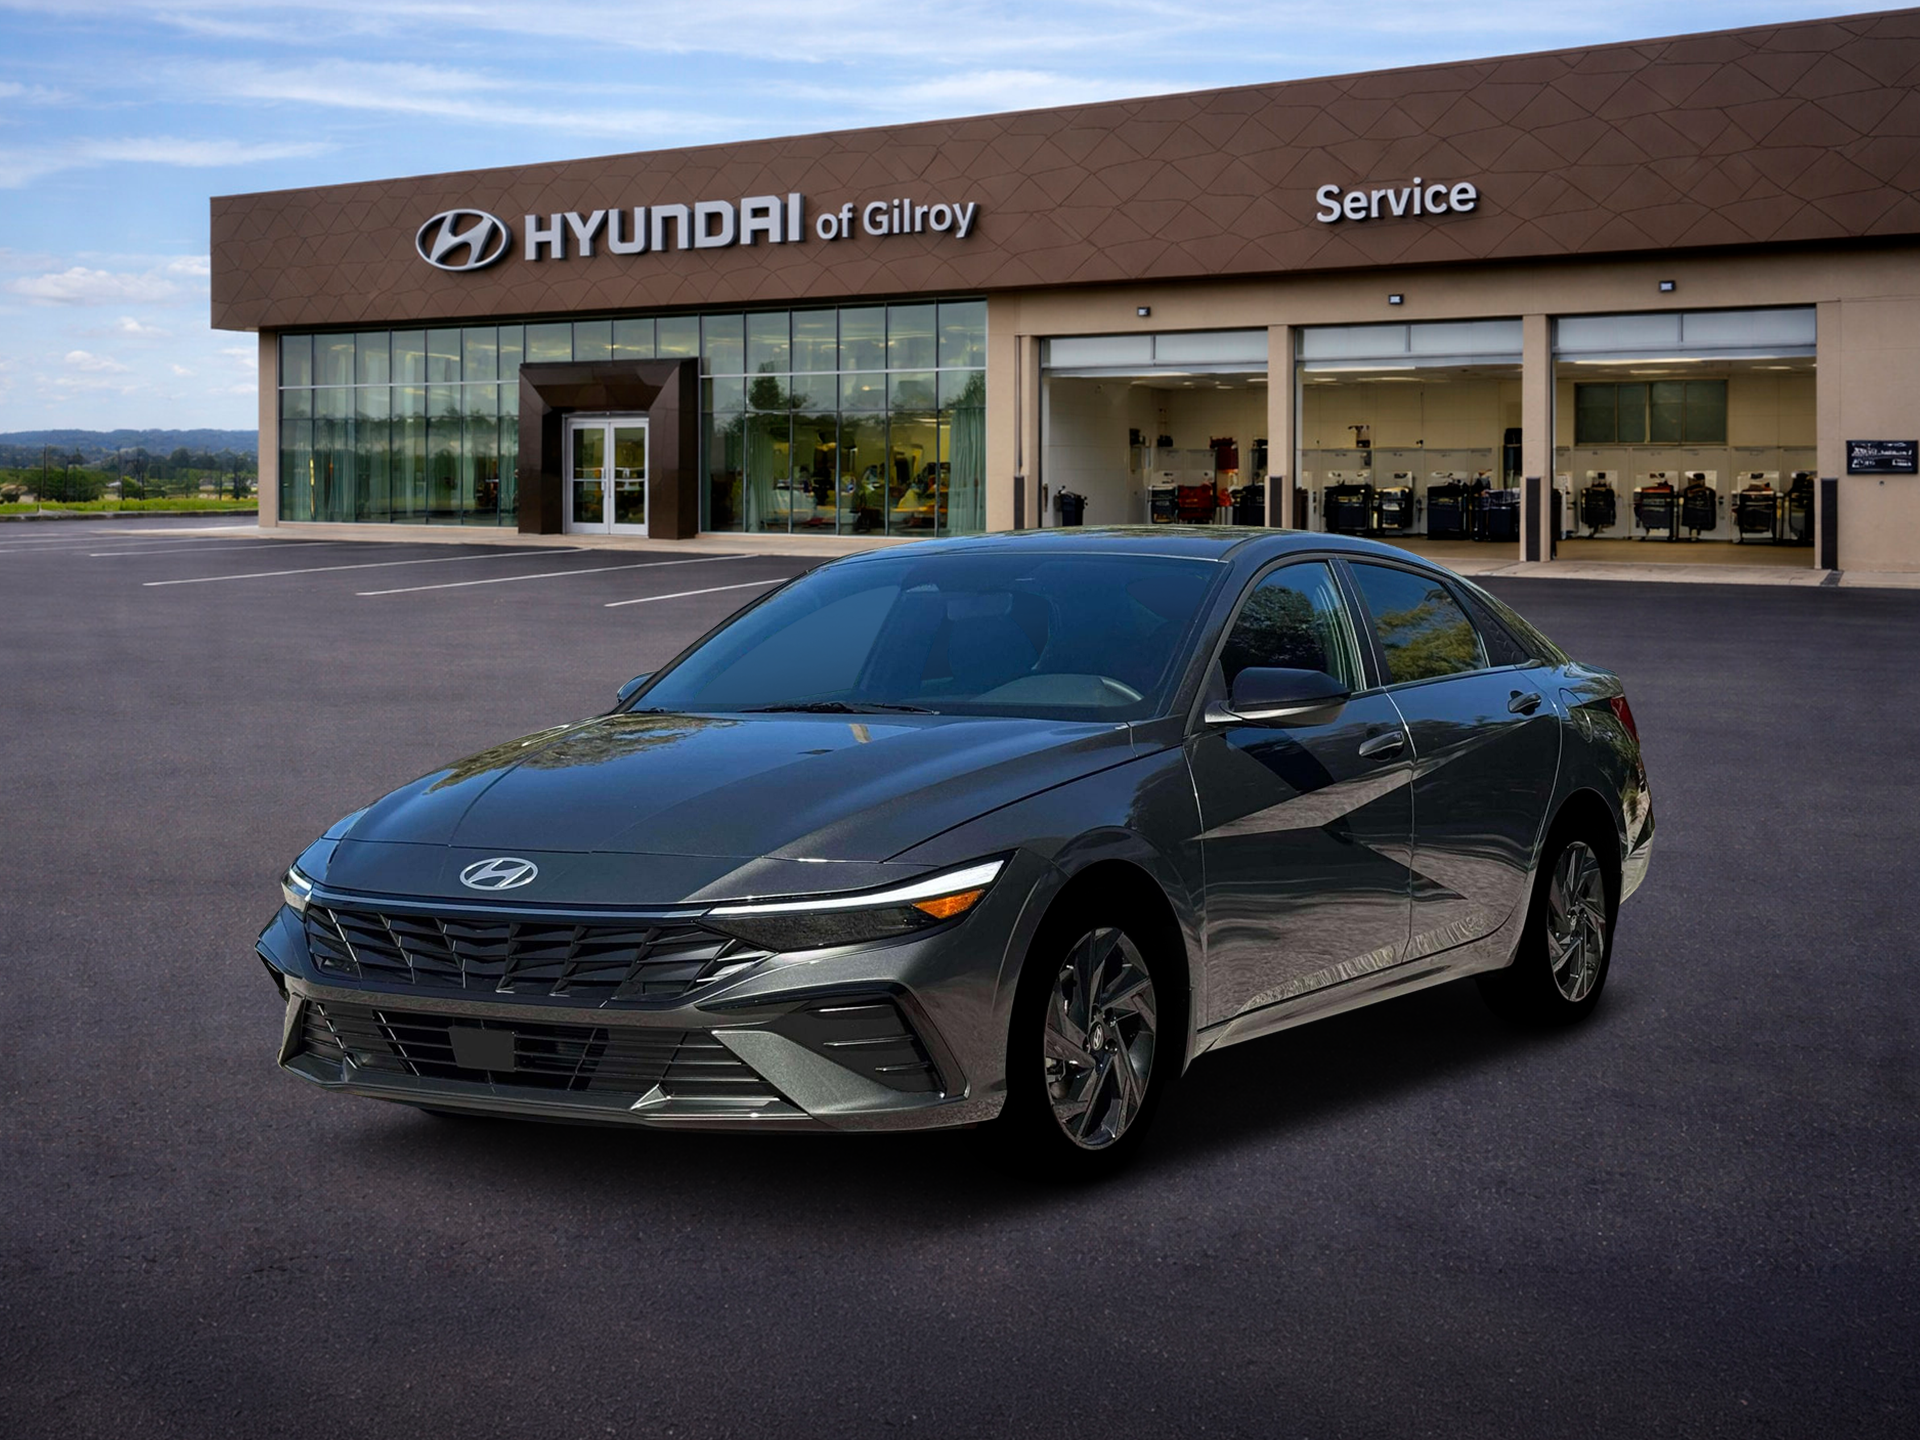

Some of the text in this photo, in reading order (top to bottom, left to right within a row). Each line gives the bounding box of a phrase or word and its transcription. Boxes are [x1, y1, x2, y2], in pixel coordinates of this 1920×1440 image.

[524, 193, 803, 261] HYUNDAI
[815, 203, 854, 239] of
[863, 198, 976, 239] Gilroy
[1316, 176, 1478, 223] Service
